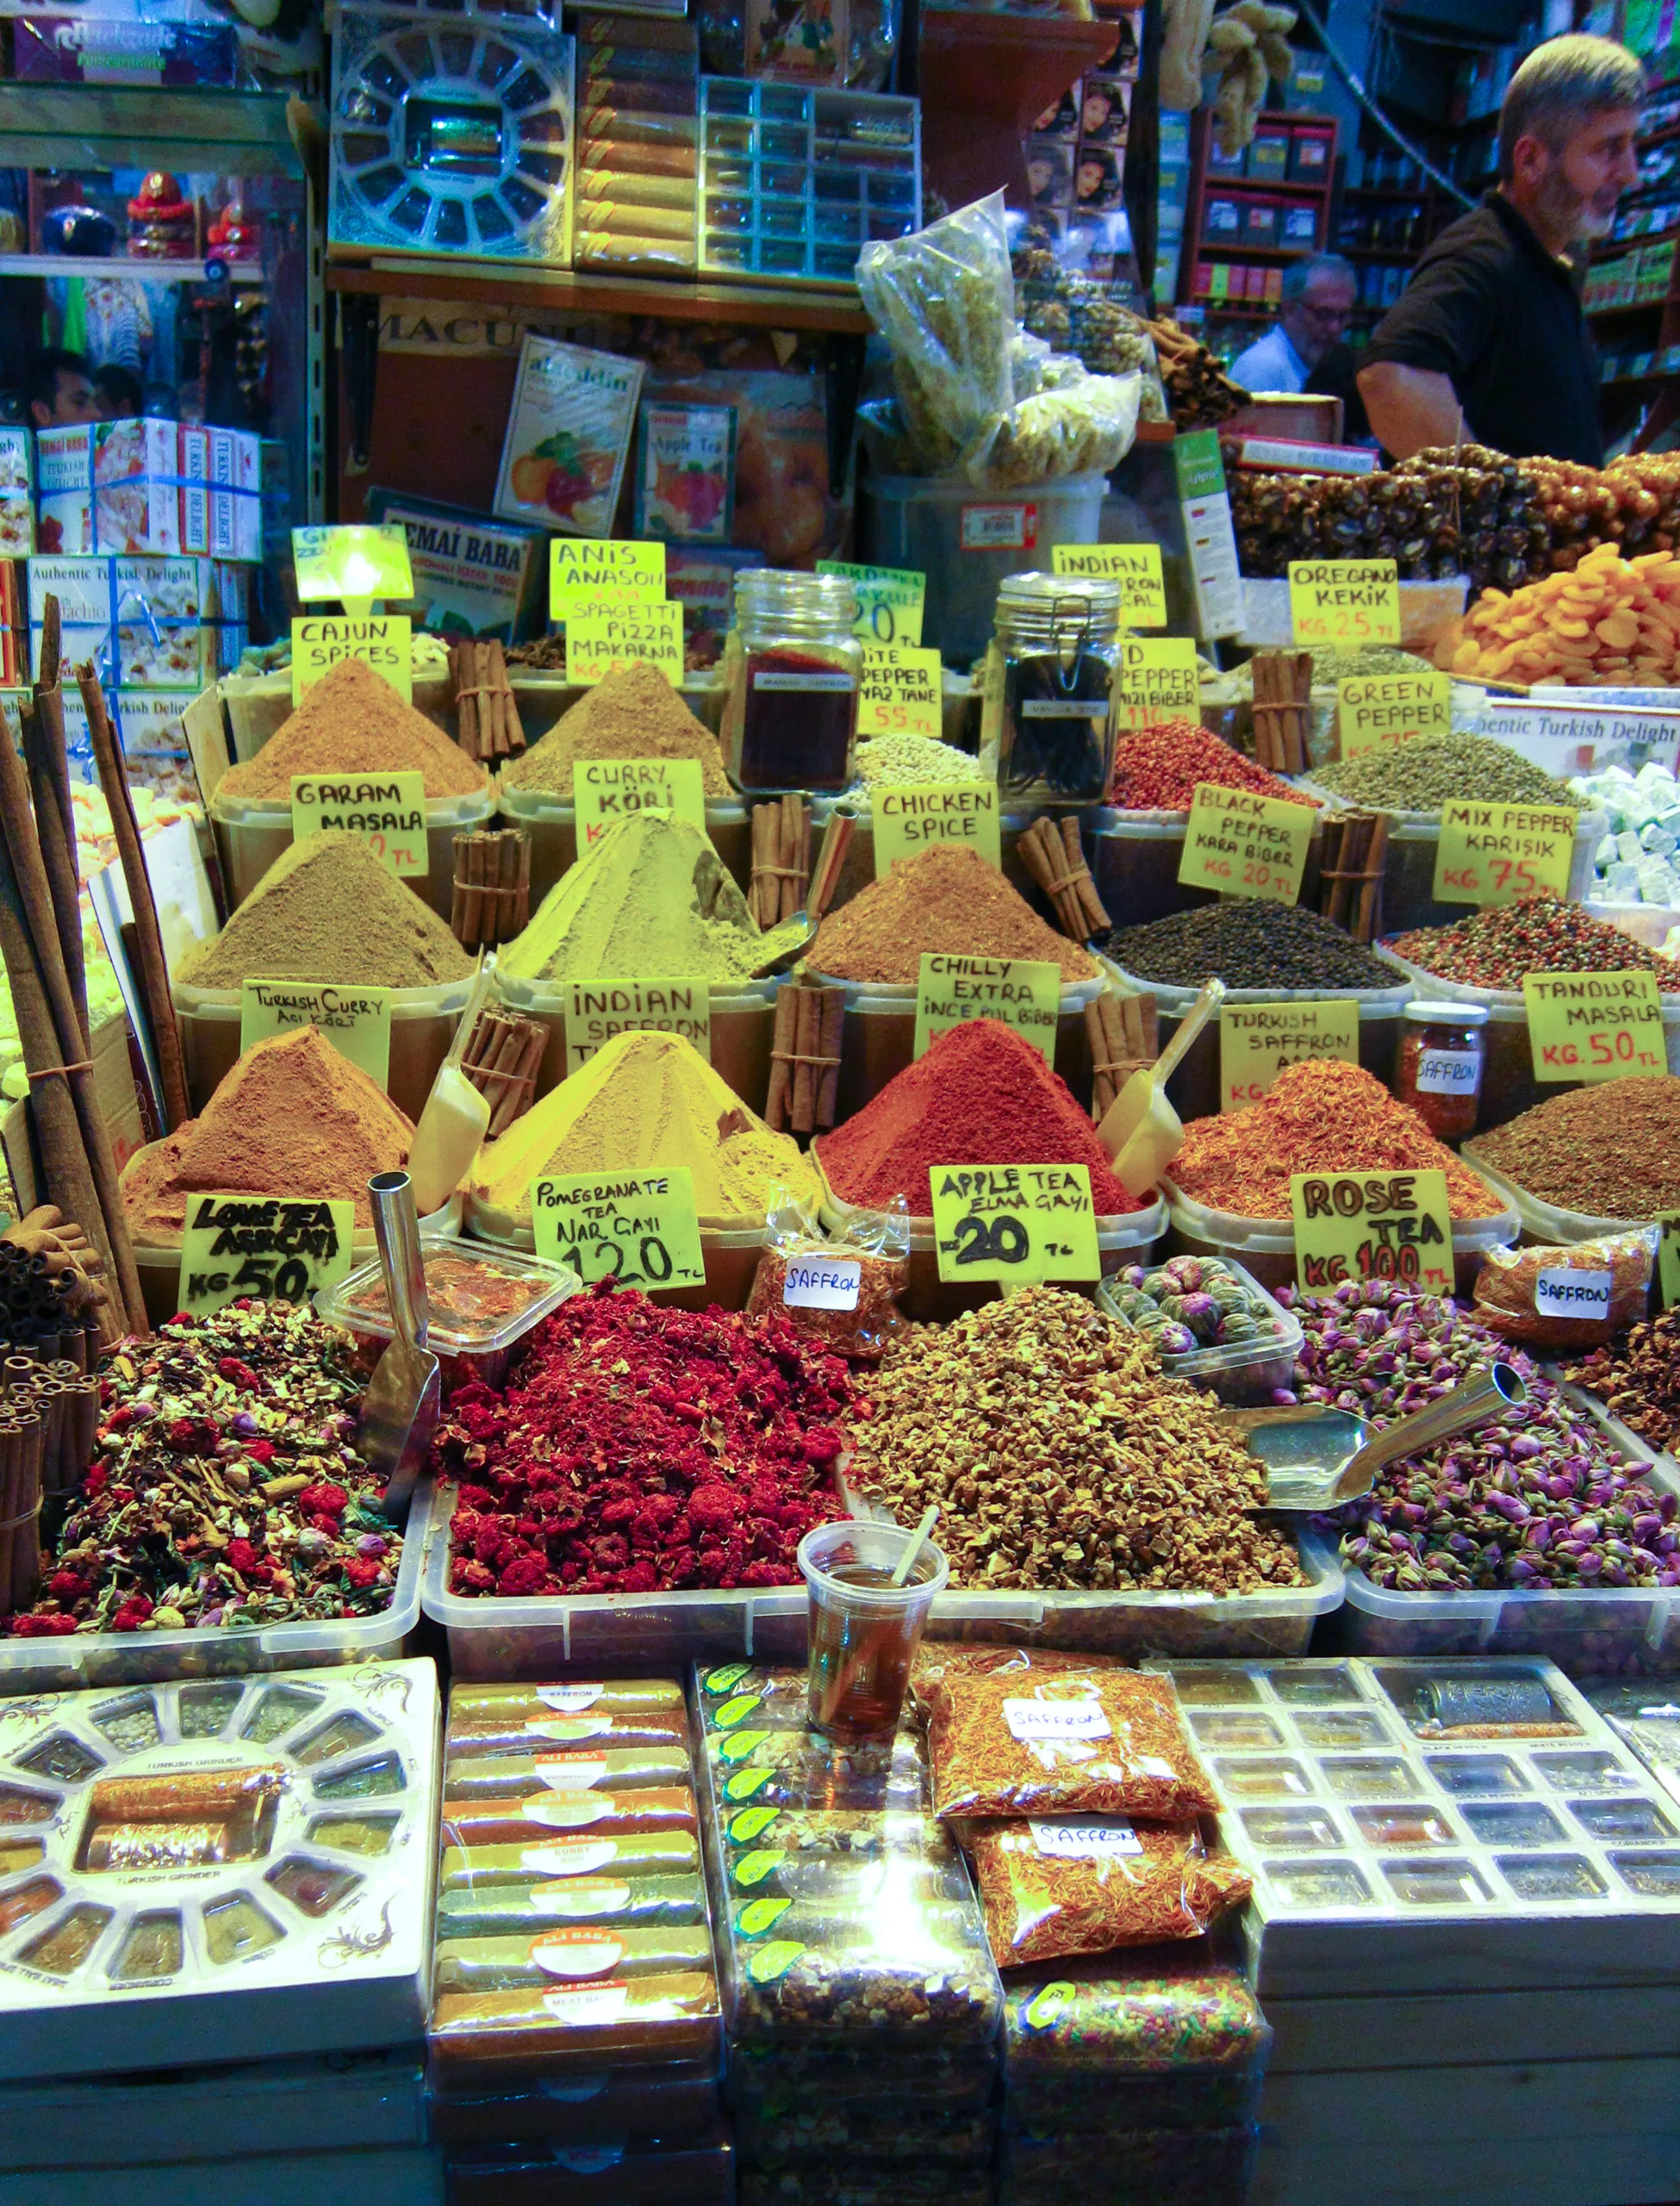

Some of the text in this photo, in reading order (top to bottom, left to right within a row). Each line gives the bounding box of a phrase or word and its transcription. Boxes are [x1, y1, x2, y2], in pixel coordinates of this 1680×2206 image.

[464, 535, 522, 573] BABA
[33, 564, 91, 581] Authentic
[146, 565, 192, 585] Delight
[1294, 565, 1397, 586] OREGANO
[301, 621, 388, 642] CAJUN
[1336, 612, 1371, 637] 25
[572, 639, 678, 659] MAKARNA
[897, 689, 938, 704] TANE
[1342, 682, 1434, 705] GREEN
[874, 705, 909, 729] 55
[1356, 702, 1449, 728] PEPPER
[1539, 717, 1607, 739] Turkish
[1612, 720, 1677, 744] Delight
[586, 764, 666, 784] CURRY
[296, 782, 402, 806] GARAM
[882, 790, 992, 815] CHICKEN
[1199, 787, 1266, 819] BLACK
[320, 810, 423, 832] MASALA
[904, 816, 979, 840] SPICE
[1221, 816, 1292, 847] PEPPER
[1447, 807, 1575, 837] MIX PEPPER
[1195, 832, 1239, 854] KARA
[391, 849, 420, 868] TL
[1204, 857, 1294, 895] KG 20 TL
[1442, 868, 1479, 890] KG
[1487, 859, 1540, 894] 75
[930, 957, 1012, 980] CHILLY
[248, 986, 383, 1016] TURKISH CURRY
[954, 979, 1034, 1004] EXTRA
[1533, 979, 1649, 1000] TANDURI
[1228, 1011, 1318, 1030] TURKISH
[1566, 1004, 1661, 1027] MASALA
[1248, 1033, 1351, 1051] SAFFRON
[1589, 1031, 1635, 1066] 50
[1637, 1052, 1661, 1067] TL
[1418, 1058, 1477, 1081] SAFFRON
[537, 1177, 669, 1208] POMEGRANATE
[939, 1168, 1083, 1200] APPLE TEA
[968, 1191, 1030, 1217] ELMA
[1303, 1175, 1418, 1218] ROSE
[581, 1201, 619, 1219] TEA
[557, 1218, 609, 1244] NAR
[953, 1214, 1030, 1266] 20
[1367, 1212, 1445, 1245] TEA
[561, 1236, 674, 1287] 120
[1303, 1239, 1453, 1287] KG 100 TL
[187, 1258, 309, 1309] KG 50
[786, 1267, 861, 1292] SAFFRON
[1538, 1279, 1609, 1303] SAFFRON
[1014, 1711, 1103, 1725] SAFFRON
[565, 1750, 598, 1761] BABA
[1040, 1826, 1136, 1846] SAFFRON
[554, 1846, 591, 1856] CURRY
